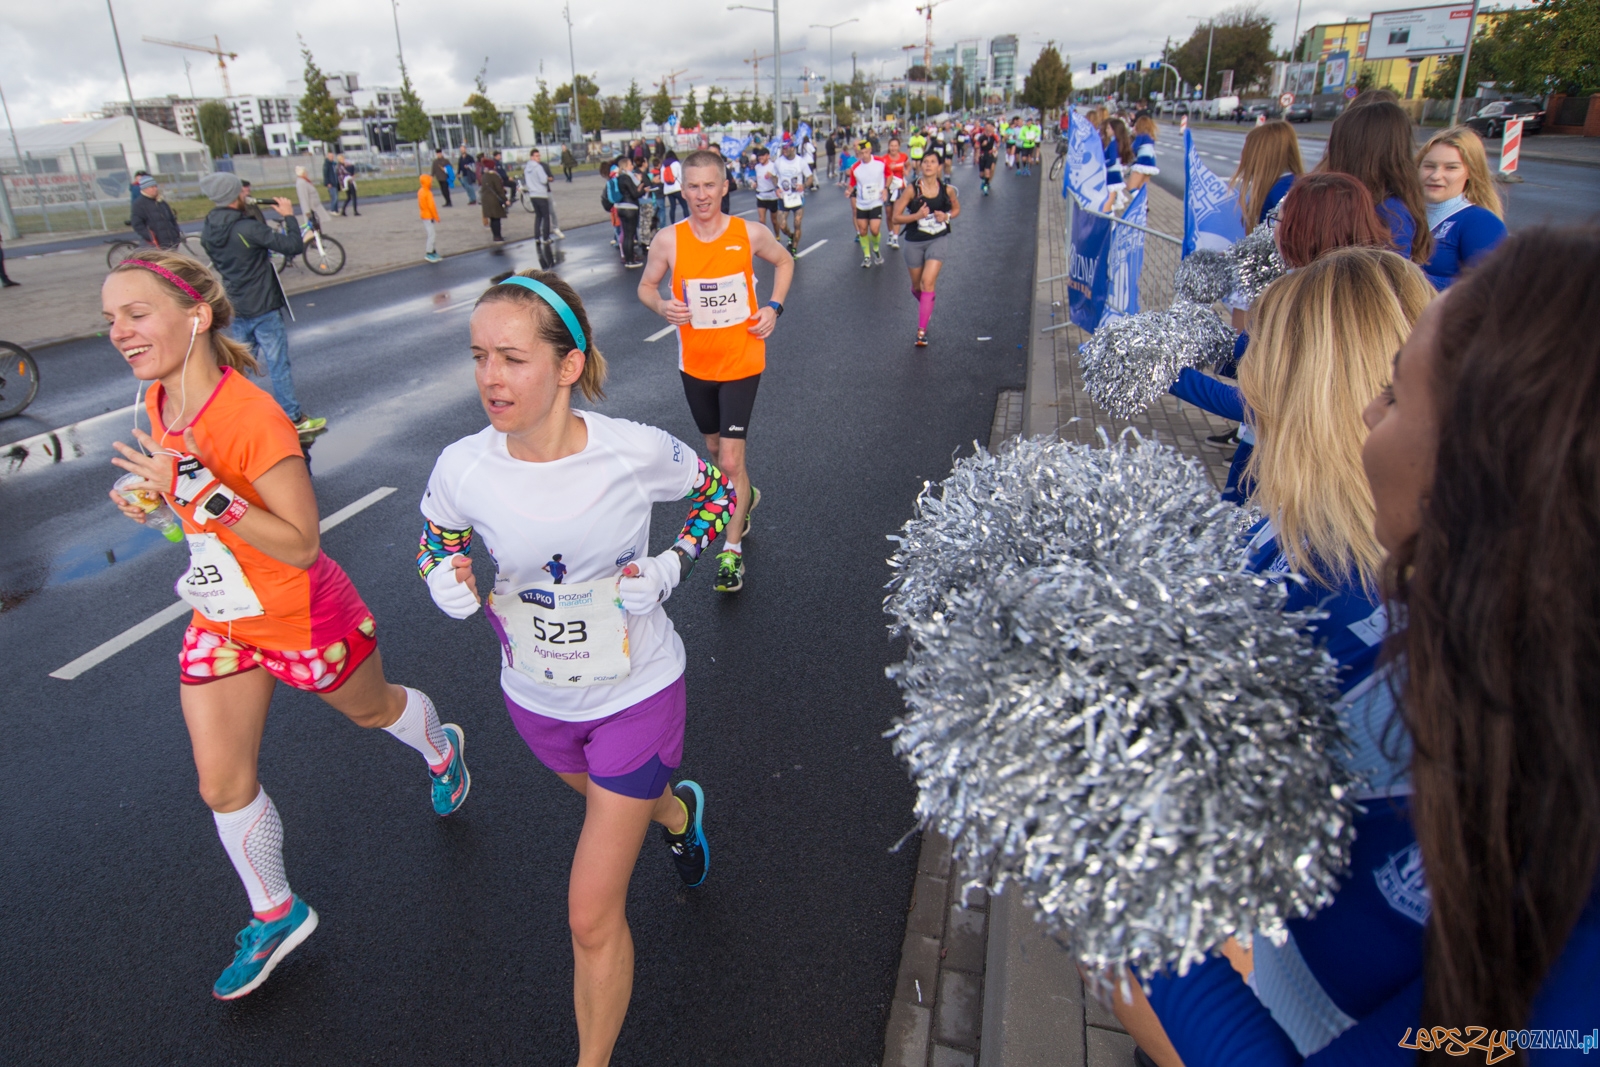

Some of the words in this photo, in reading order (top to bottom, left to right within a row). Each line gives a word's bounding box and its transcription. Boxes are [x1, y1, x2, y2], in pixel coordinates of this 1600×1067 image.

[1200, 168, 1227, 200] LECH
[700, 293, 737, 307] 3624
[523, 592, 552, 604] 17.PKO
[558, 598, 593, 607] maraton
[533, 616, 588, 644] 523
[534, 645, 590, 660] Agnieszka
[568, 675, 582, 683] 4F
